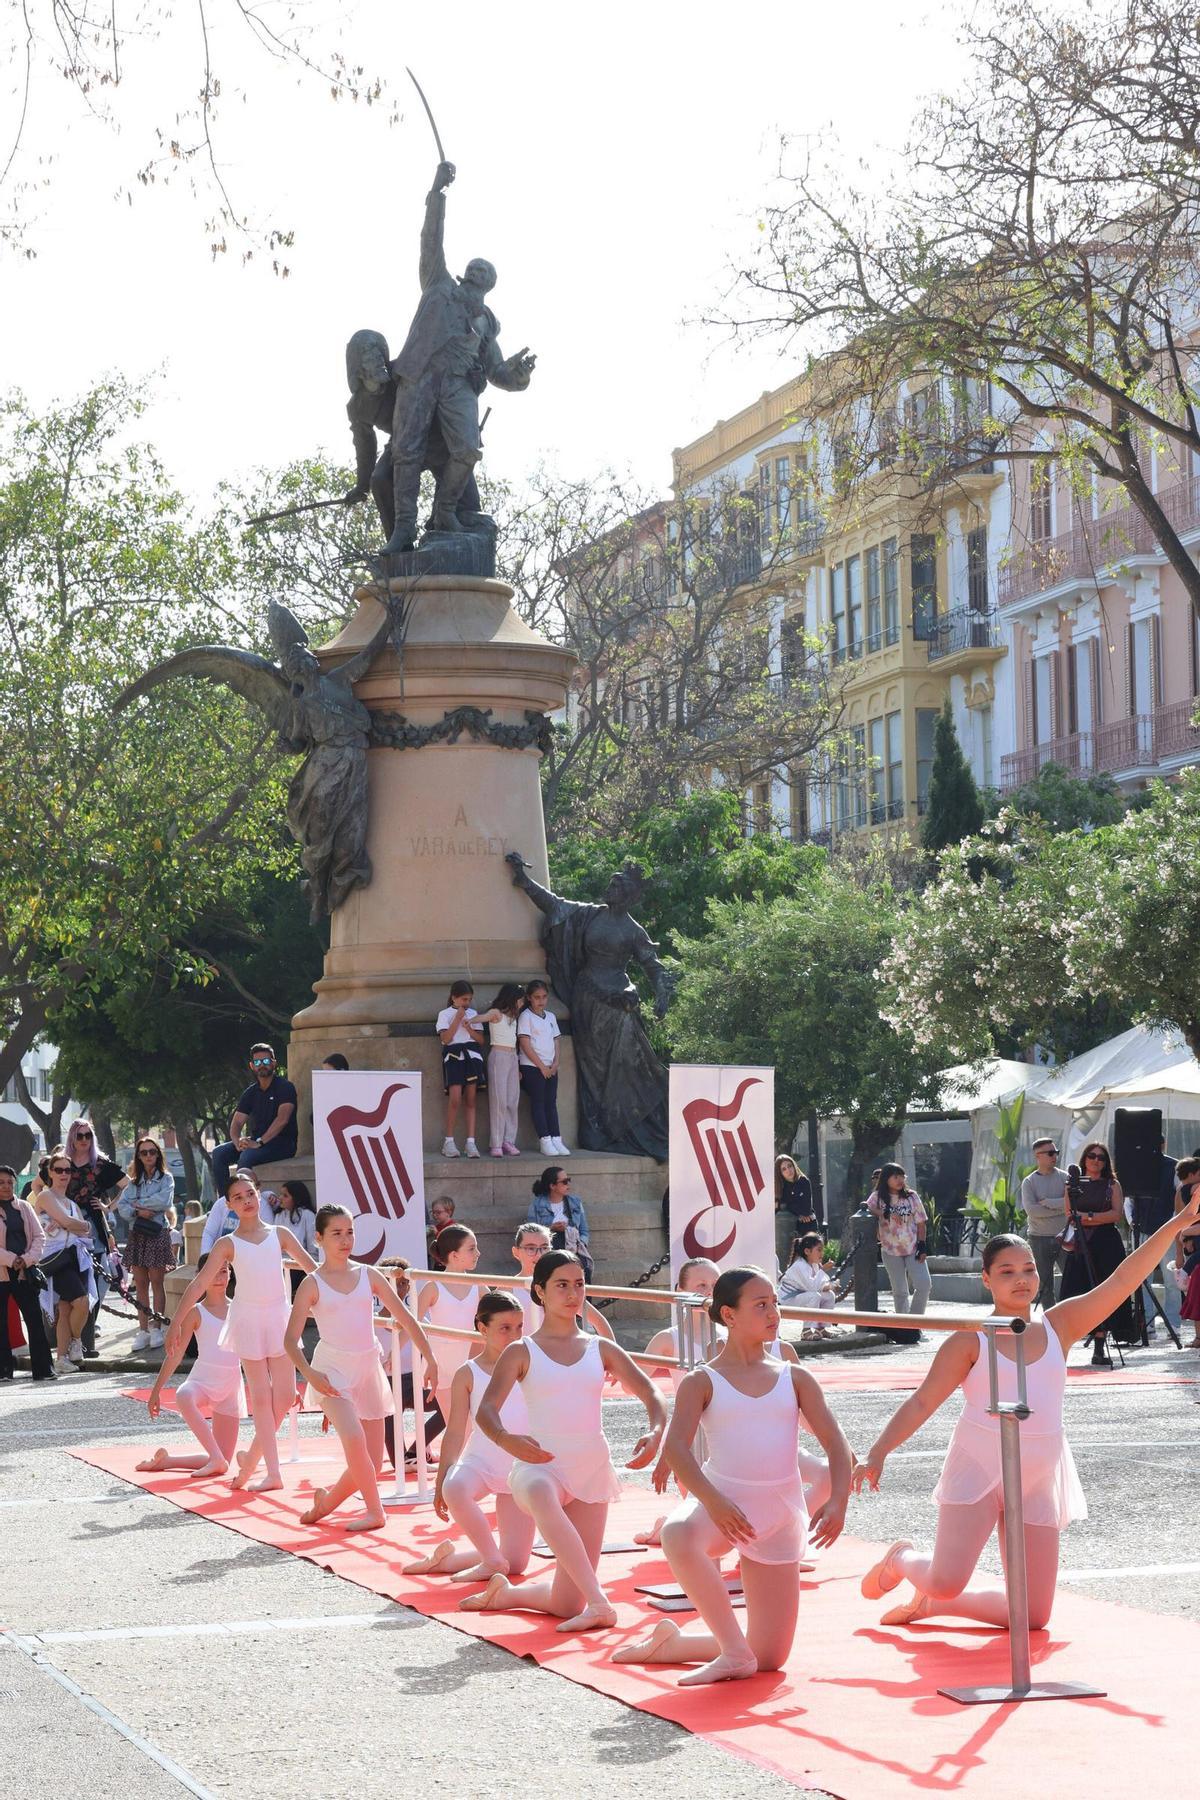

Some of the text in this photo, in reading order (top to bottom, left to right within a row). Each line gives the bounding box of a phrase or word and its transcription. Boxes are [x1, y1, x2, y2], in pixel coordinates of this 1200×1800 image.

[454, 803, 468, 827] A
[410, 836, 456, 857] VARA
[476, 837, 509, 857] REY
